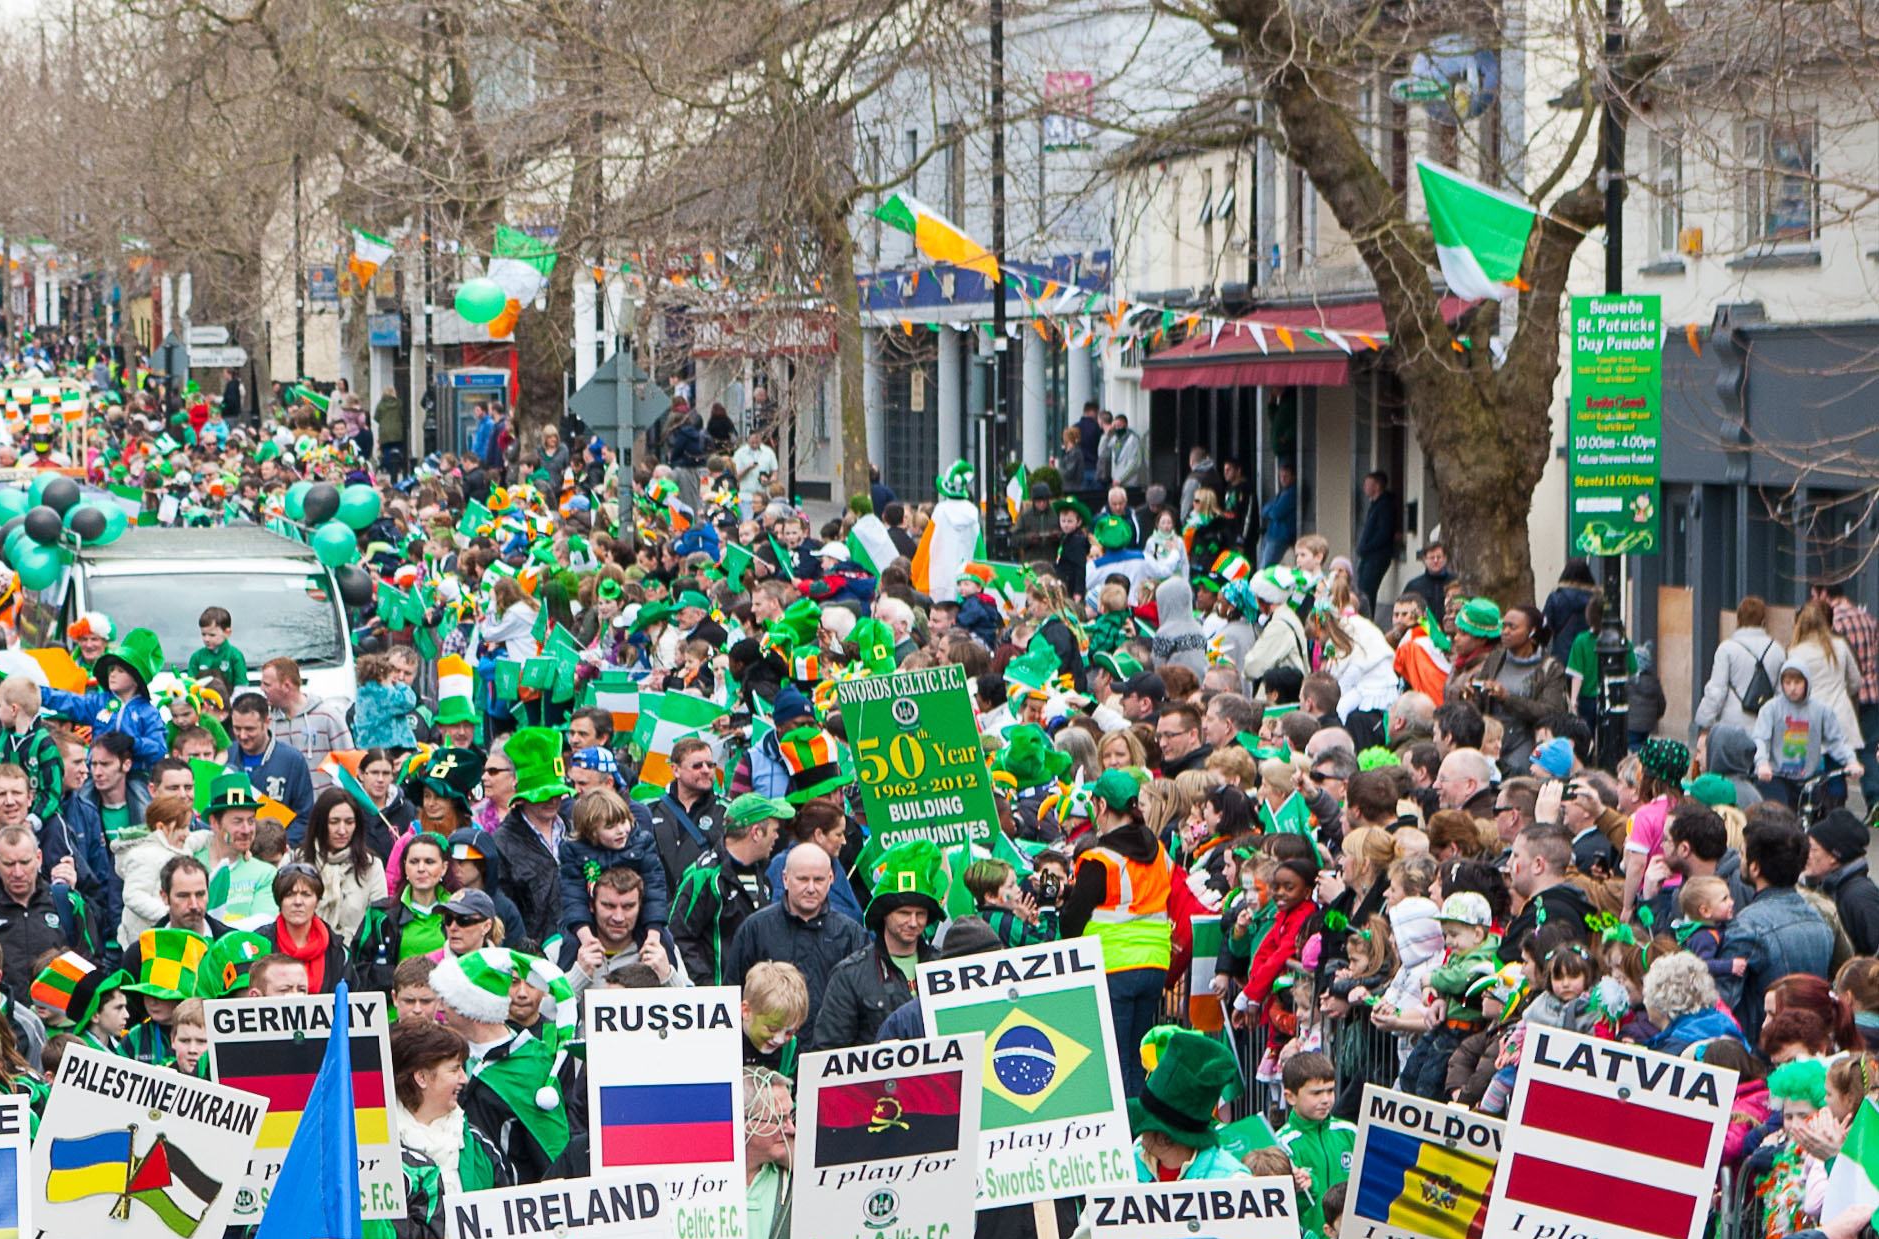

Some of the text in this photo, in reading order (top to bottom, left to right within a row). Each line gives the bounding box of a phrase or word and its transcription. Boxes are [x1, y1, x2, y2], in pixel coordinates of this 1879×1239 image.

[837, 667, 964, 705] SWORDS CELTIC F.C.
[857, 733, 978, 785] 50 Year
[874, 773, 978, 800] 1962 2012
[888, 795, 965, 823] BUILDING
[926, 948, 1096, 996] BRAZIL
[594, 1003, 734, 1034] RUSSIA
[821, 1039, 965, 1078] ANGOLA
[1531, 1033, 1721, 1108] LATVIA
[62, 1055, 259, 1136] PALESTINE/UKRAIN
[987, 1120, 1107, 1160] play for
[697, 1178, 729, 1196] for
[818, 1155, 956, 1190] I play for
[986, 1150, 1129, 1199] Swords Celtic F.C.
[371, 1184, 400, 1211] F.C.
[503, 1181, 661, 1236] IRELAND
[1095, 1188, 1288, 1226] ZANZIBAR
[677, 1205, 743, 1239] Celtic F.C.
[1509, 1212, 1528, 1233] I
